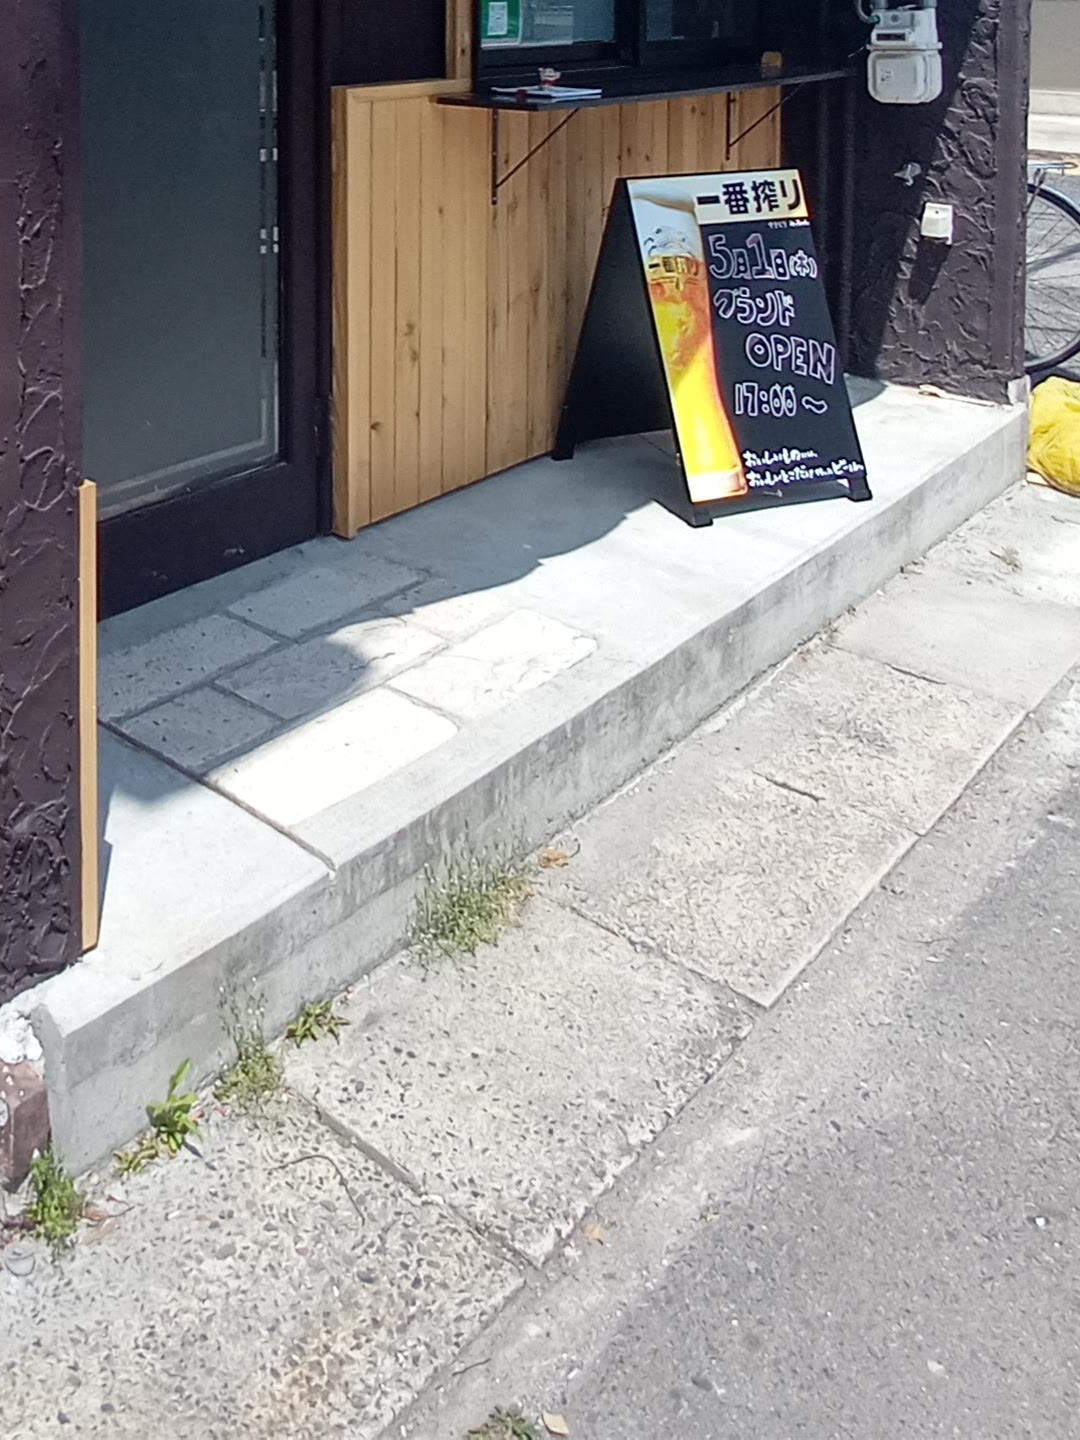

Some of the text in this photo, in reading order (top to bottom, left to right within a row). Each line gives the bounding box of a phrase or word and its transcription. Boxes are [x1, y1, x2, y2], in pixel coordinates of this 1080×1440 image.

[696, 179, 801, 215] 一番搾り
[713, 287, 796, 327] グランド
[746, 333, 836, 385] OPEN
